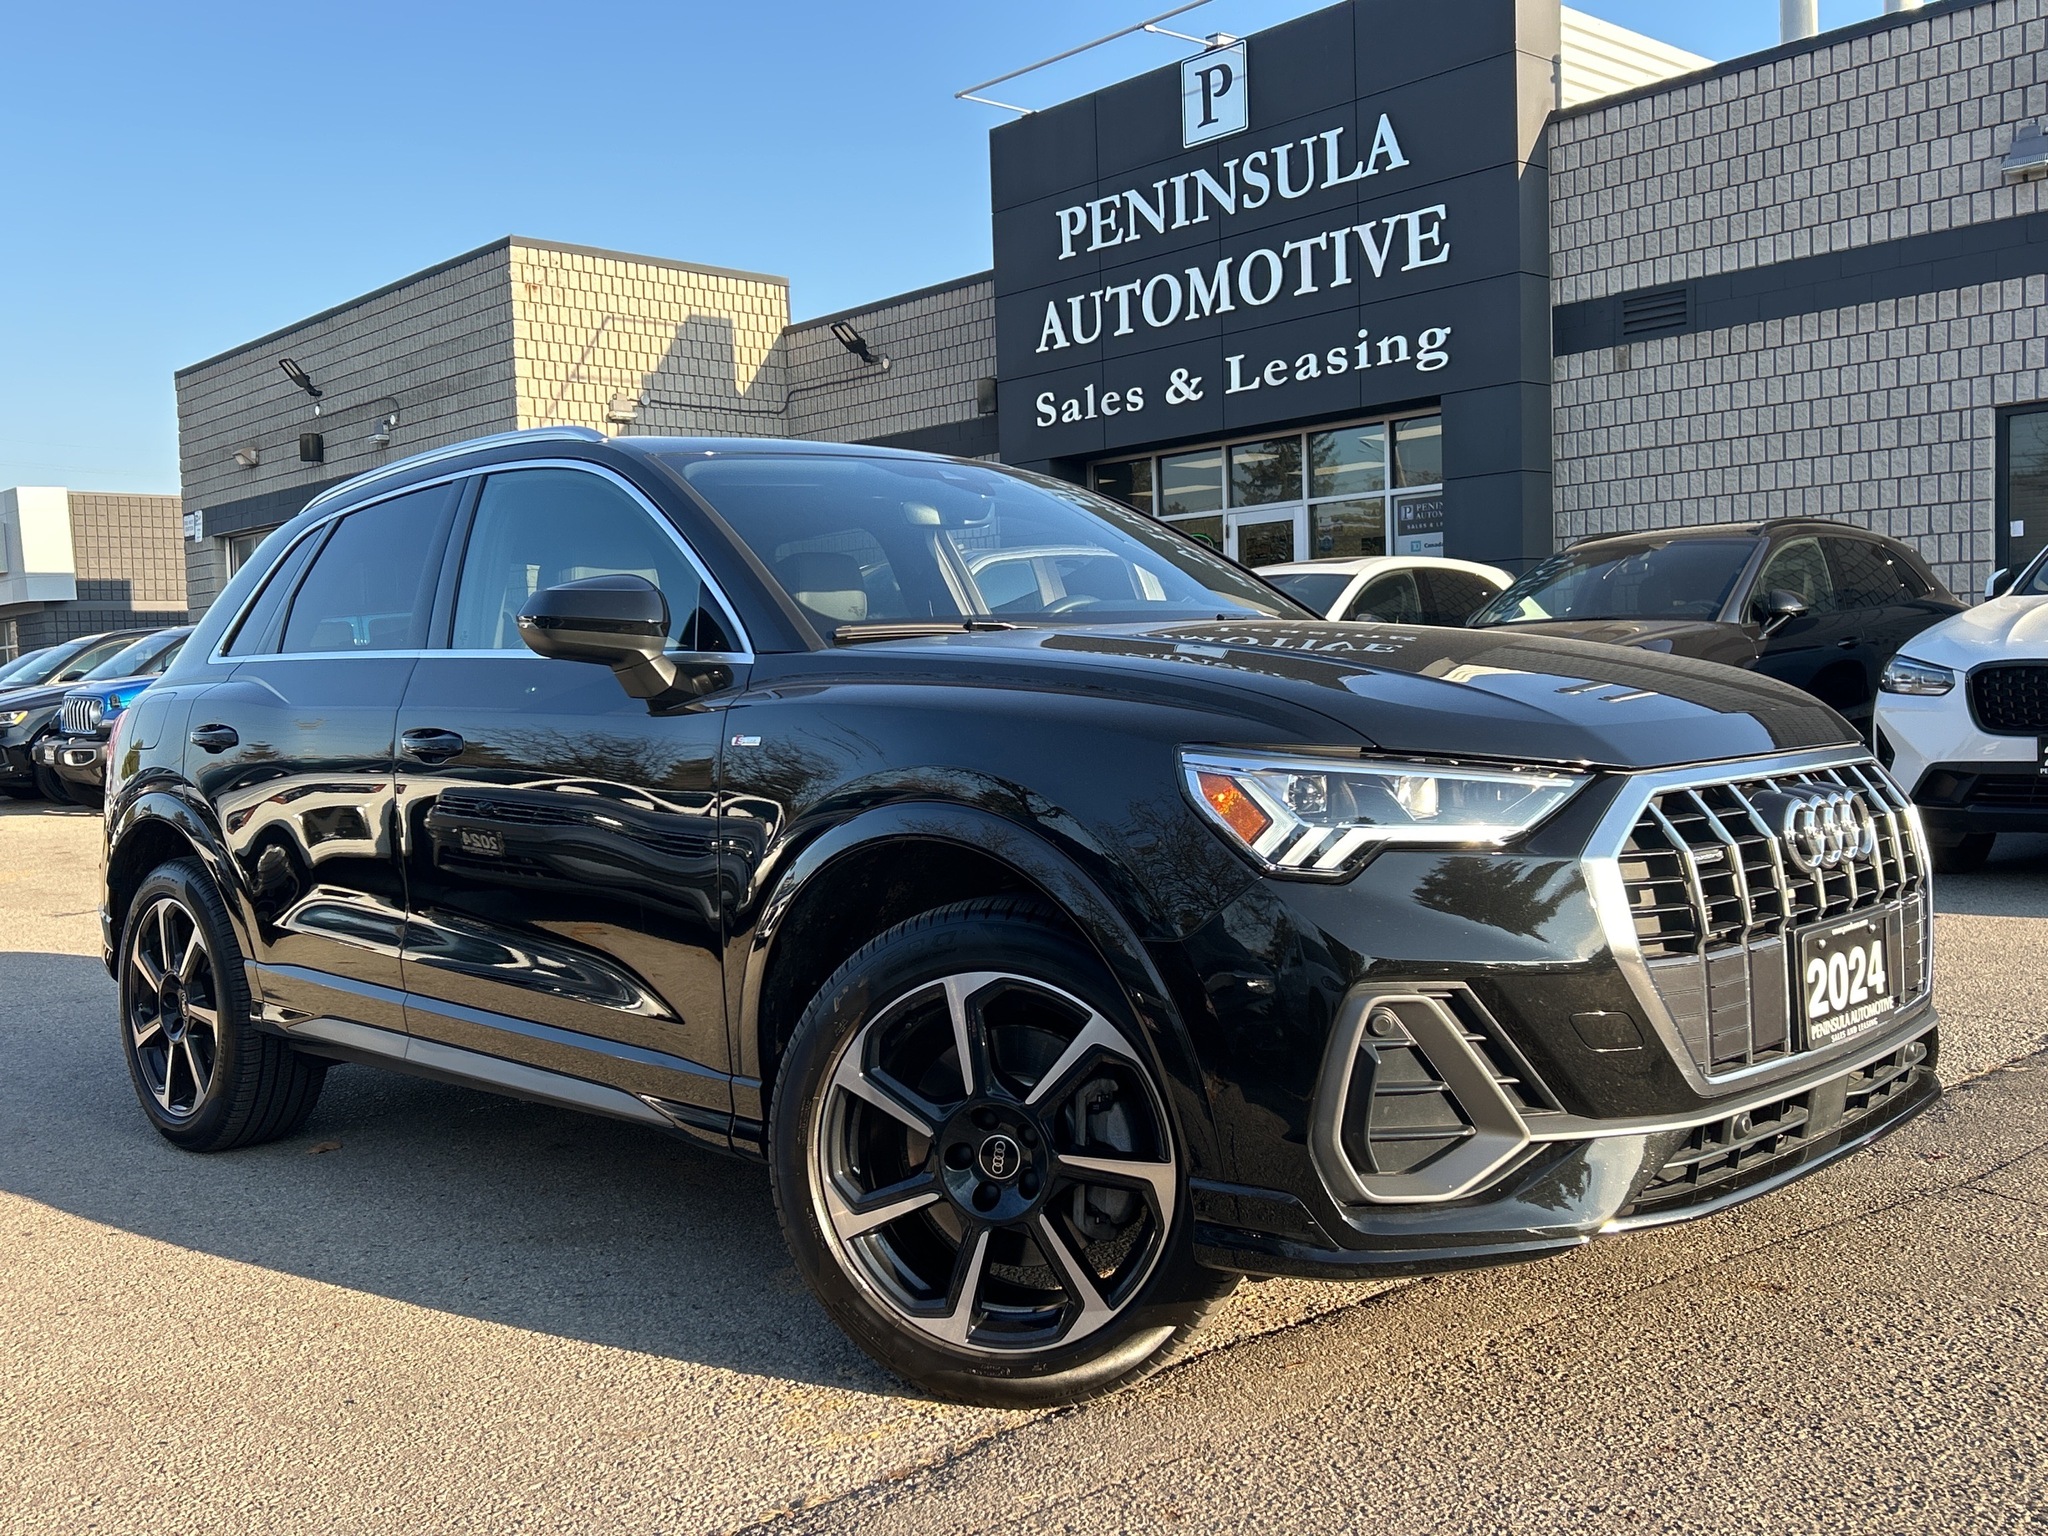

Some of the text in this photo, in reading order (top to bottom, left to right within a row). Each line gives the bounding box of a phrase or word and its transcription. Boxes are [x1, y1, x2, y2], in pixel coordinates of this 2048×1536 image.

[1194, 63, 1233, 129] P
[1056, 113, 1409, 260] PENINSULA
[1035, 203, 1450, 353] AUTOMOTIVE
[1035, 326, 1451, 427] Sales & Leasing
[1807, 940, 1886, 1019] 2024
[1811, 995, 1894, 1040] PENINSULA AUTOMOTIVE
